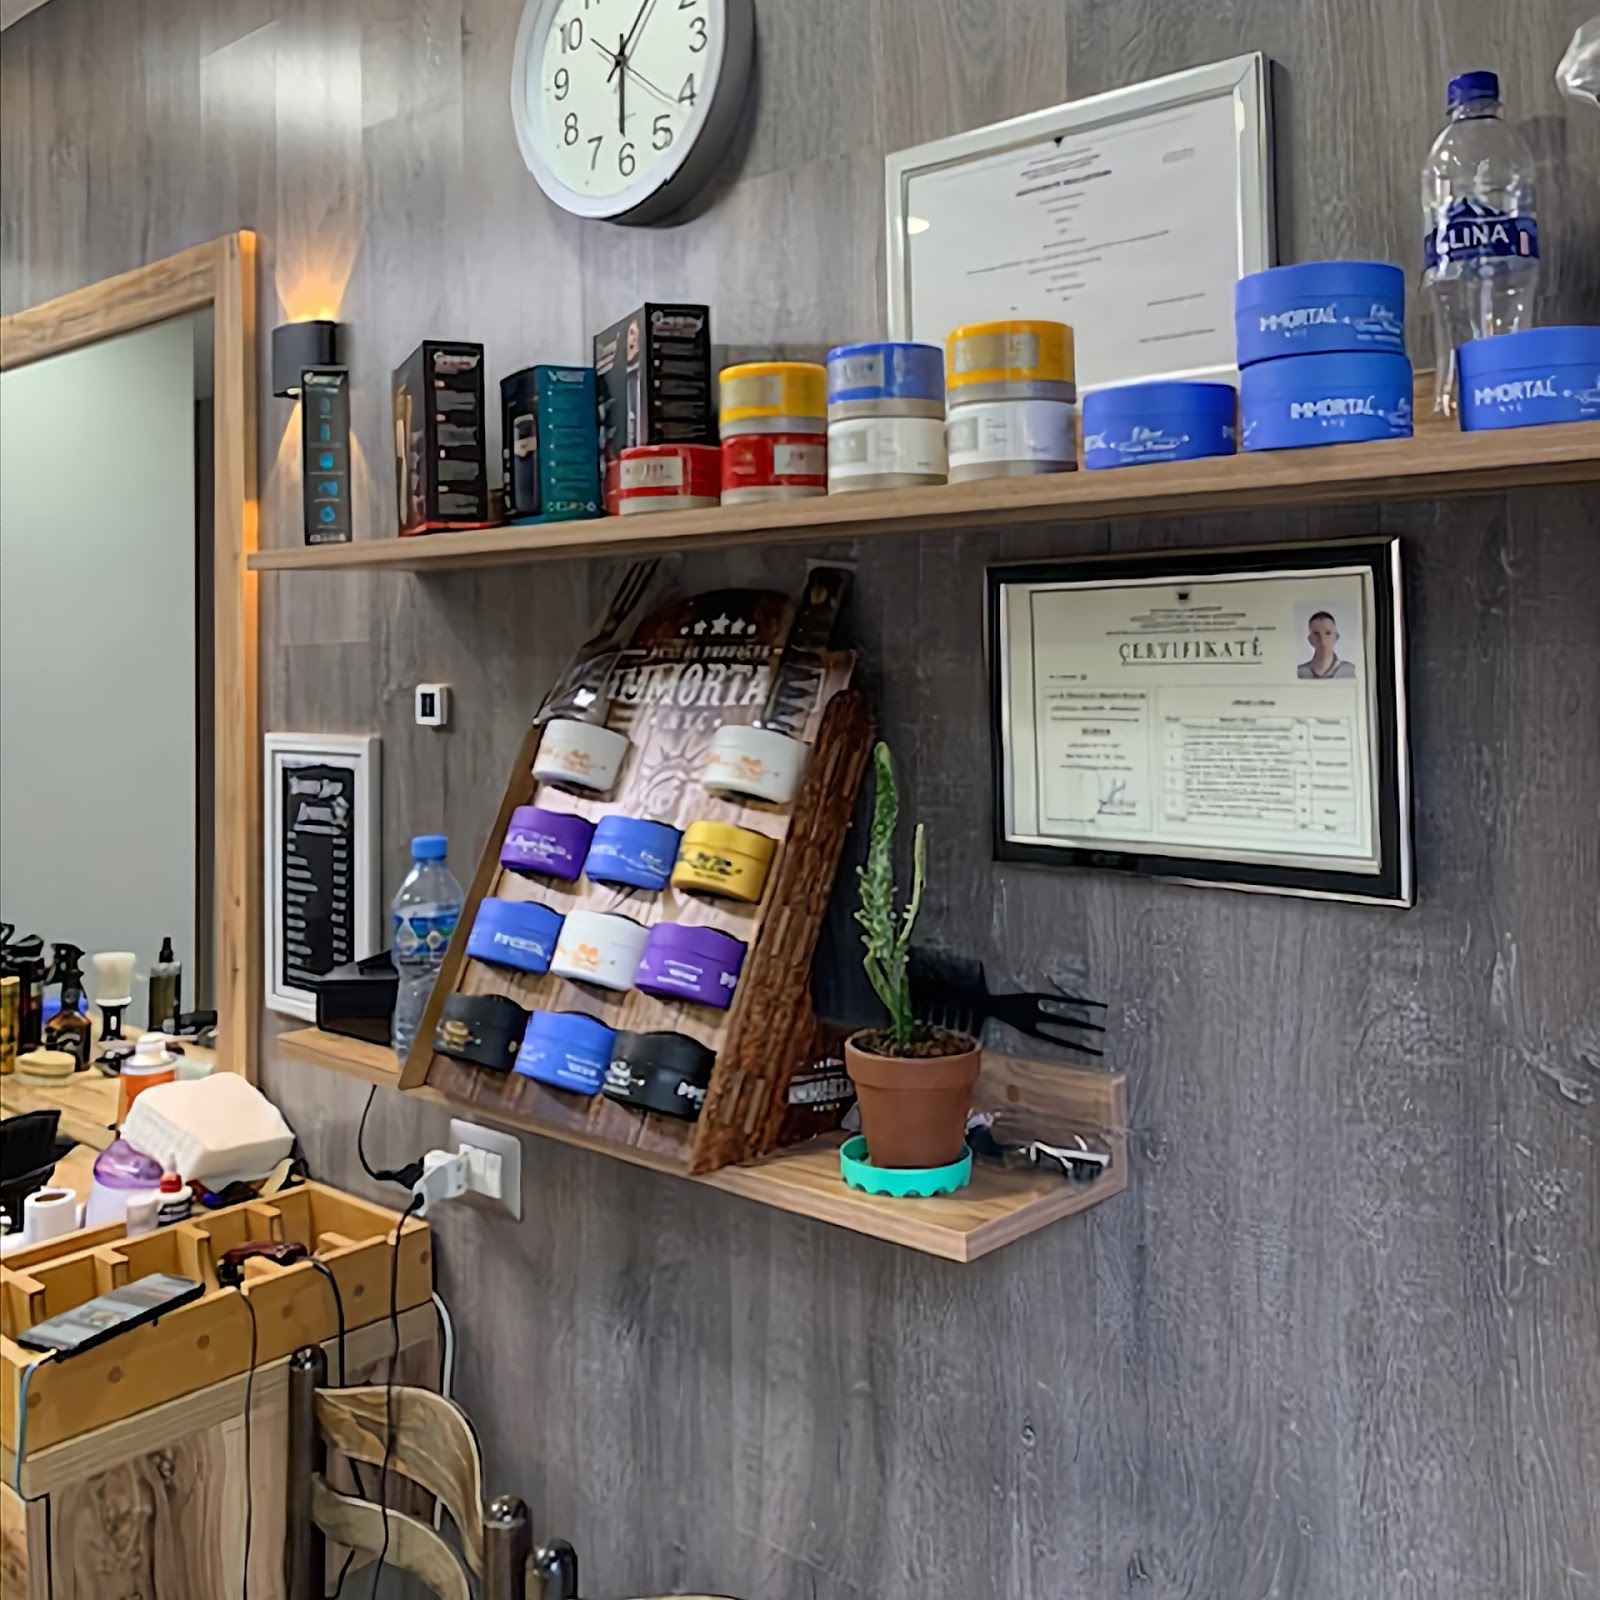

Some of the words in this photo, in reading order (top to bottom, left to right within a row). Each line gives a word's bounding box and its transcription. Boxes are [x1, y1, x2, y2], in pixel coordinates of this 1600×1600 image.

[560, 18, 582, 54] 10
[689, 17, 707, 52] 3
[554, 68, 569, 100] 9
[678, 73, 696, 106] 4
[564, 112, 578, 145] 8
[652, 115, 673, 150] 5
[588, 136, 603, 170] 7
[618, 143, 635, 176] 6
